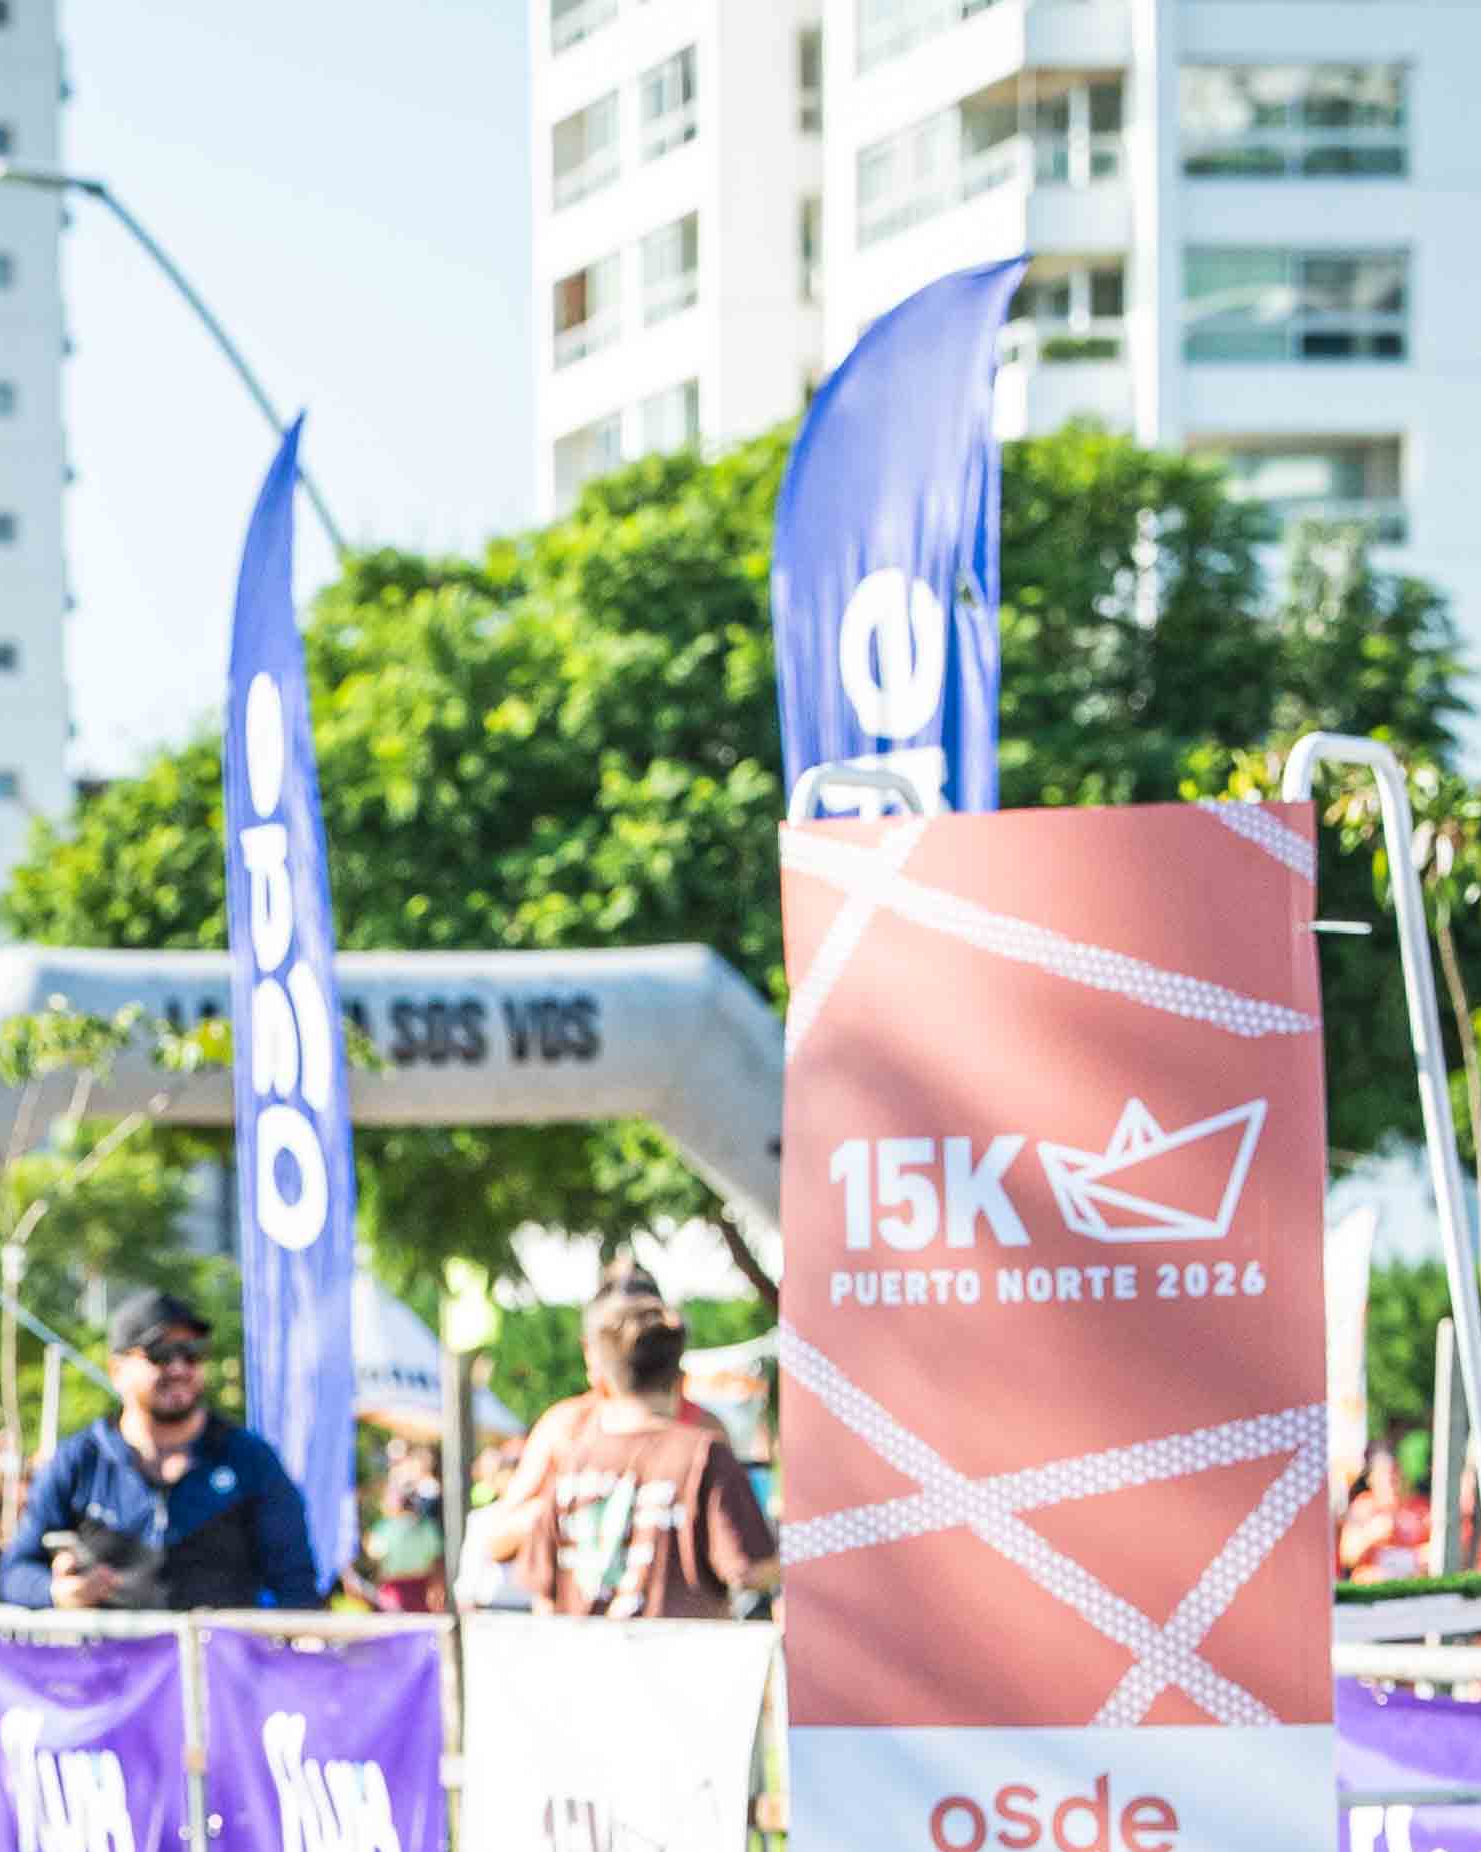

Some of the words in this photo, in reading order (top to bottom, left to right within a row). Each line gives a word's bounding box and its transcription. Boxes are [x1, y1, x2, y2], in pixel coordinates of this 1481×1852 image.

[829, 1135, 1032, 1250] 15K
[830, 1269, 981, 1306] PUERTO
[997, 1264, 1139, 1302] NORTE
[1156, 1260, 1267, 1298] 2026
